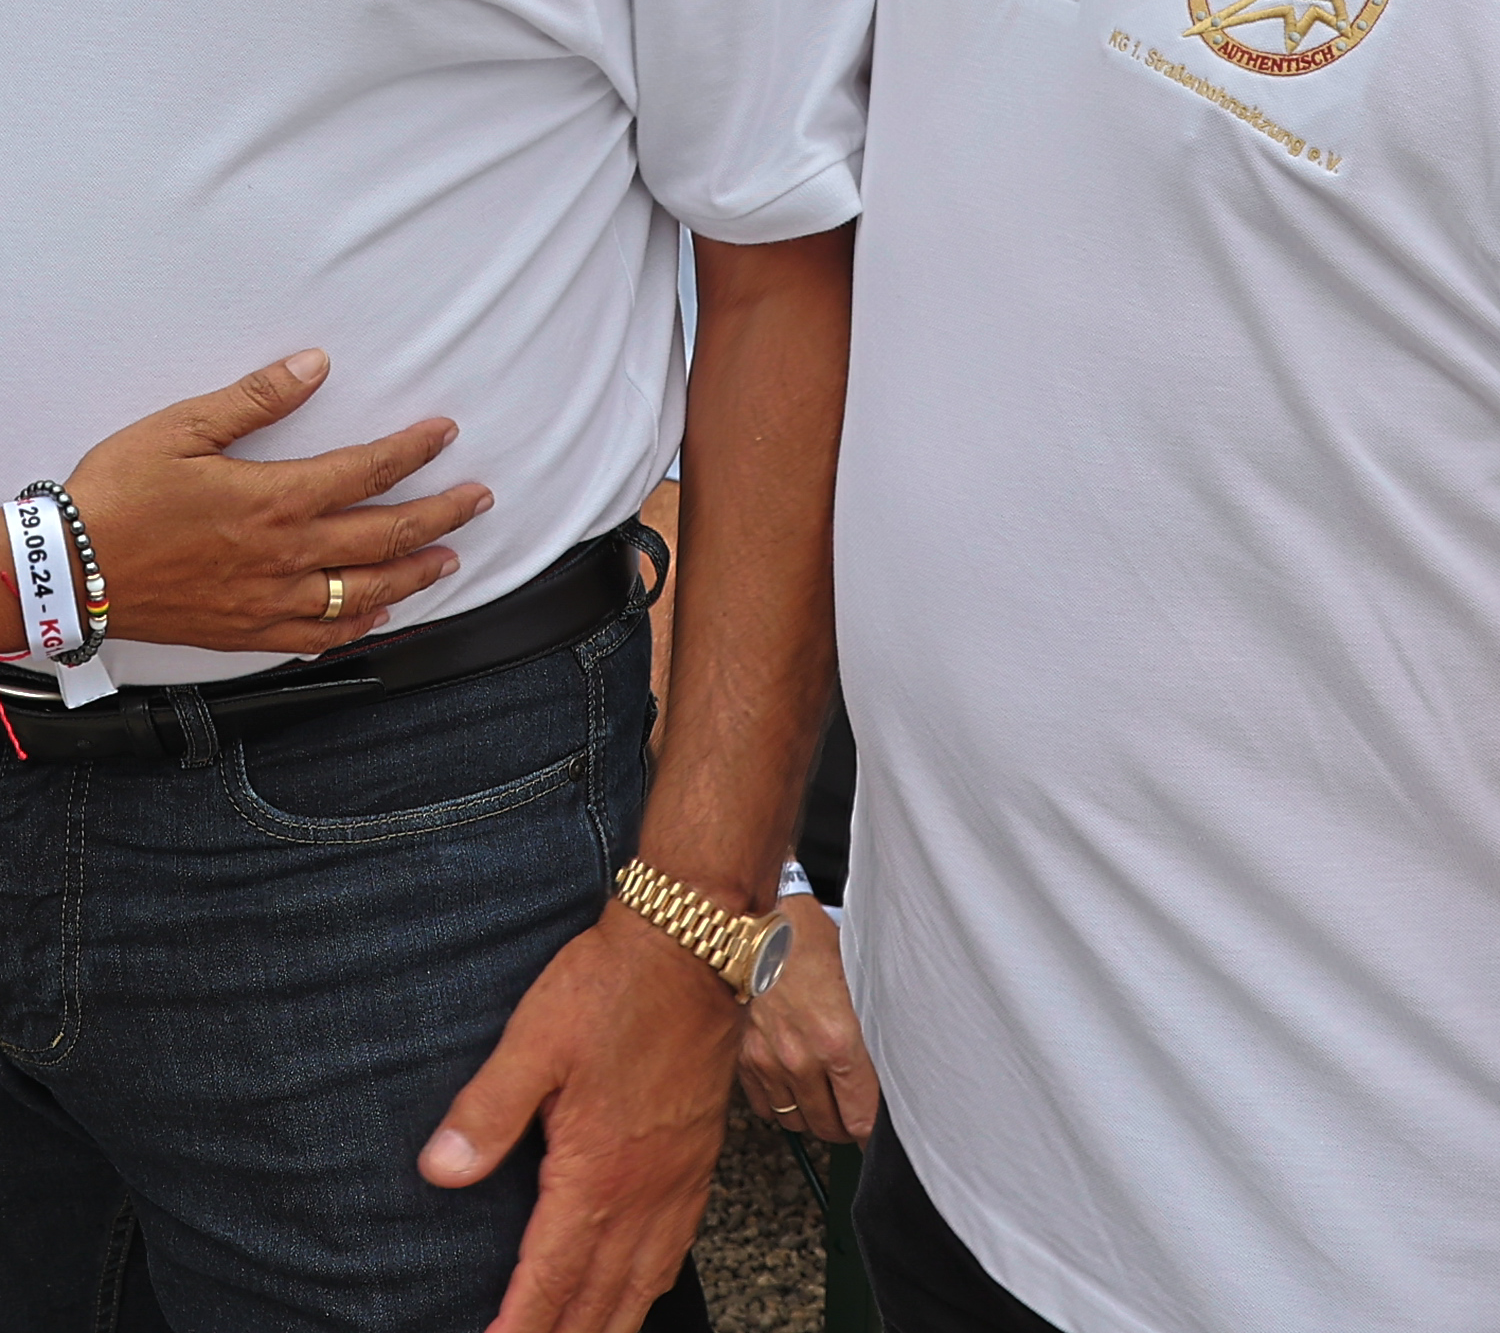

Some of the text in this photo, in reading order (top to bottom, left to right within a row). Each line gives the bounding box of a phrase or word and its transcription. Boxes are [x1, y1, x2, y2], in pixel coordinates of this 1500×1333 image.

[1108, 28, 1131, 53] KG
[1217, 40, 1336, 74] AUTHENTISCH
[18, 505, 54, 599] 29.06.24
